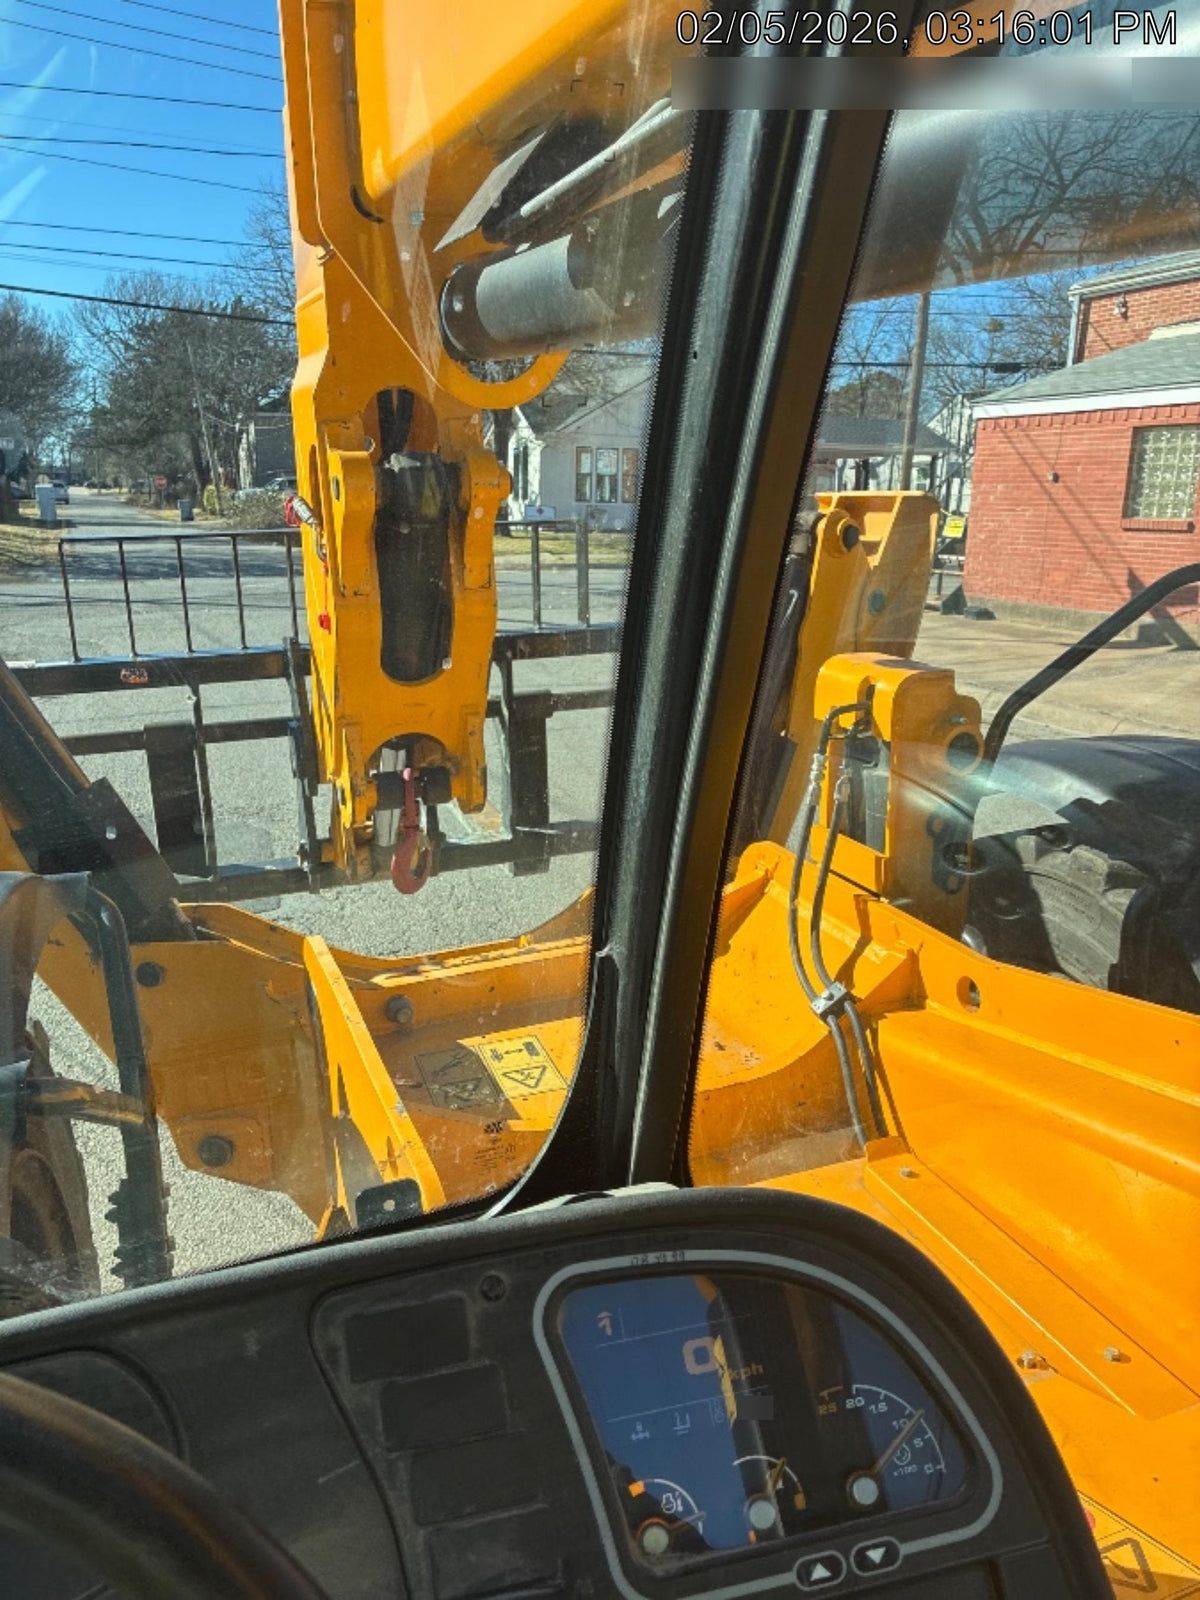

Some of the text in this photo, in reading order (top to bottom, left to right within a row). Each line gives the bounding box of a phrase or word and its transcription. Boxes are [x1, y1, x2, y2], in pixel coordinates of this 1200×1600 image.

[817, 1401, 838, 1416] 25
[845, 1396, 865, 1409] 20
[868, 1402, 888, 1415] 15
[892, 1418, 909, 1431] 10
[913, 1437, 924, 1448] 5
